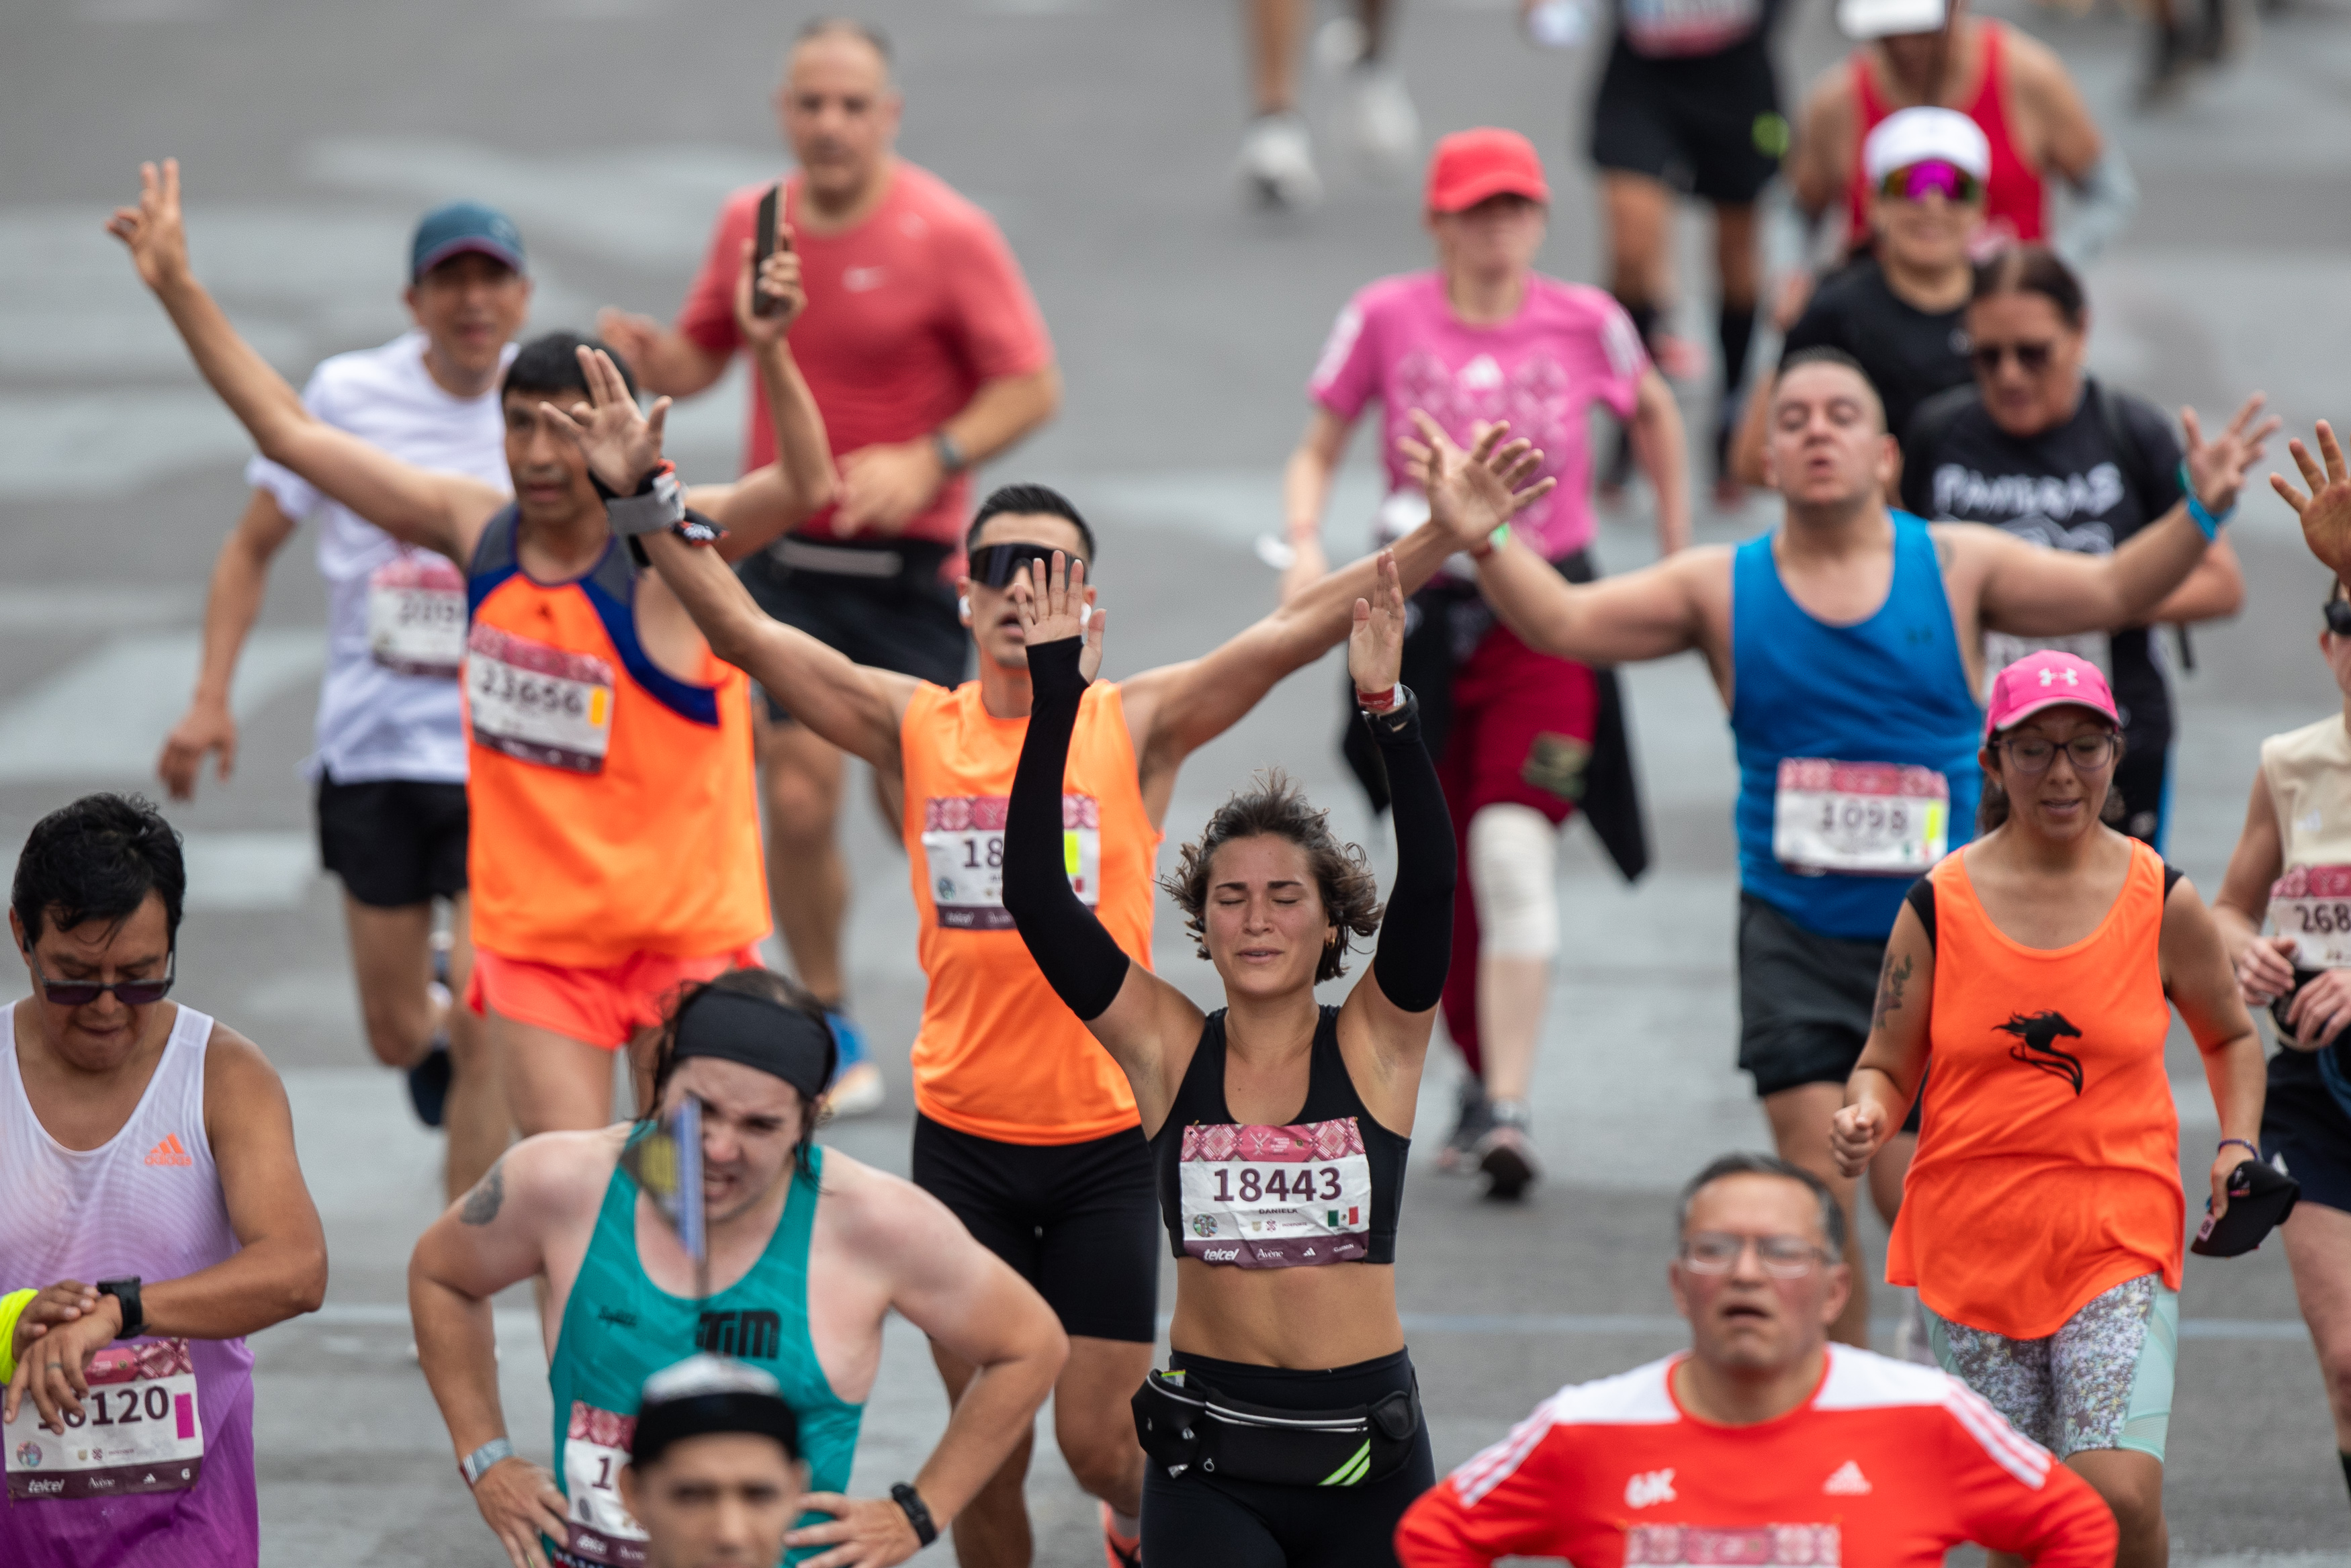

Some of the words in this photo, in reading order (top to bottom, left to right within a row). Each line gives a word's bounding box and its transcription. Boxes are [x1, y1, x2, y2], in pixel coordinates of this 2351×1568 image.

[963, 838, 1004, 868] 18
[2295, 903, 2351, 933] 268
[144, 1154, 193, 1166] adidas
[1213, 1167, 1342, 1202] 18443
[1203, 1248, 1239, 1261] telcel
[38, 1386, 169, 1429] 6120
[28, 1479, 64, 1493] telcel
